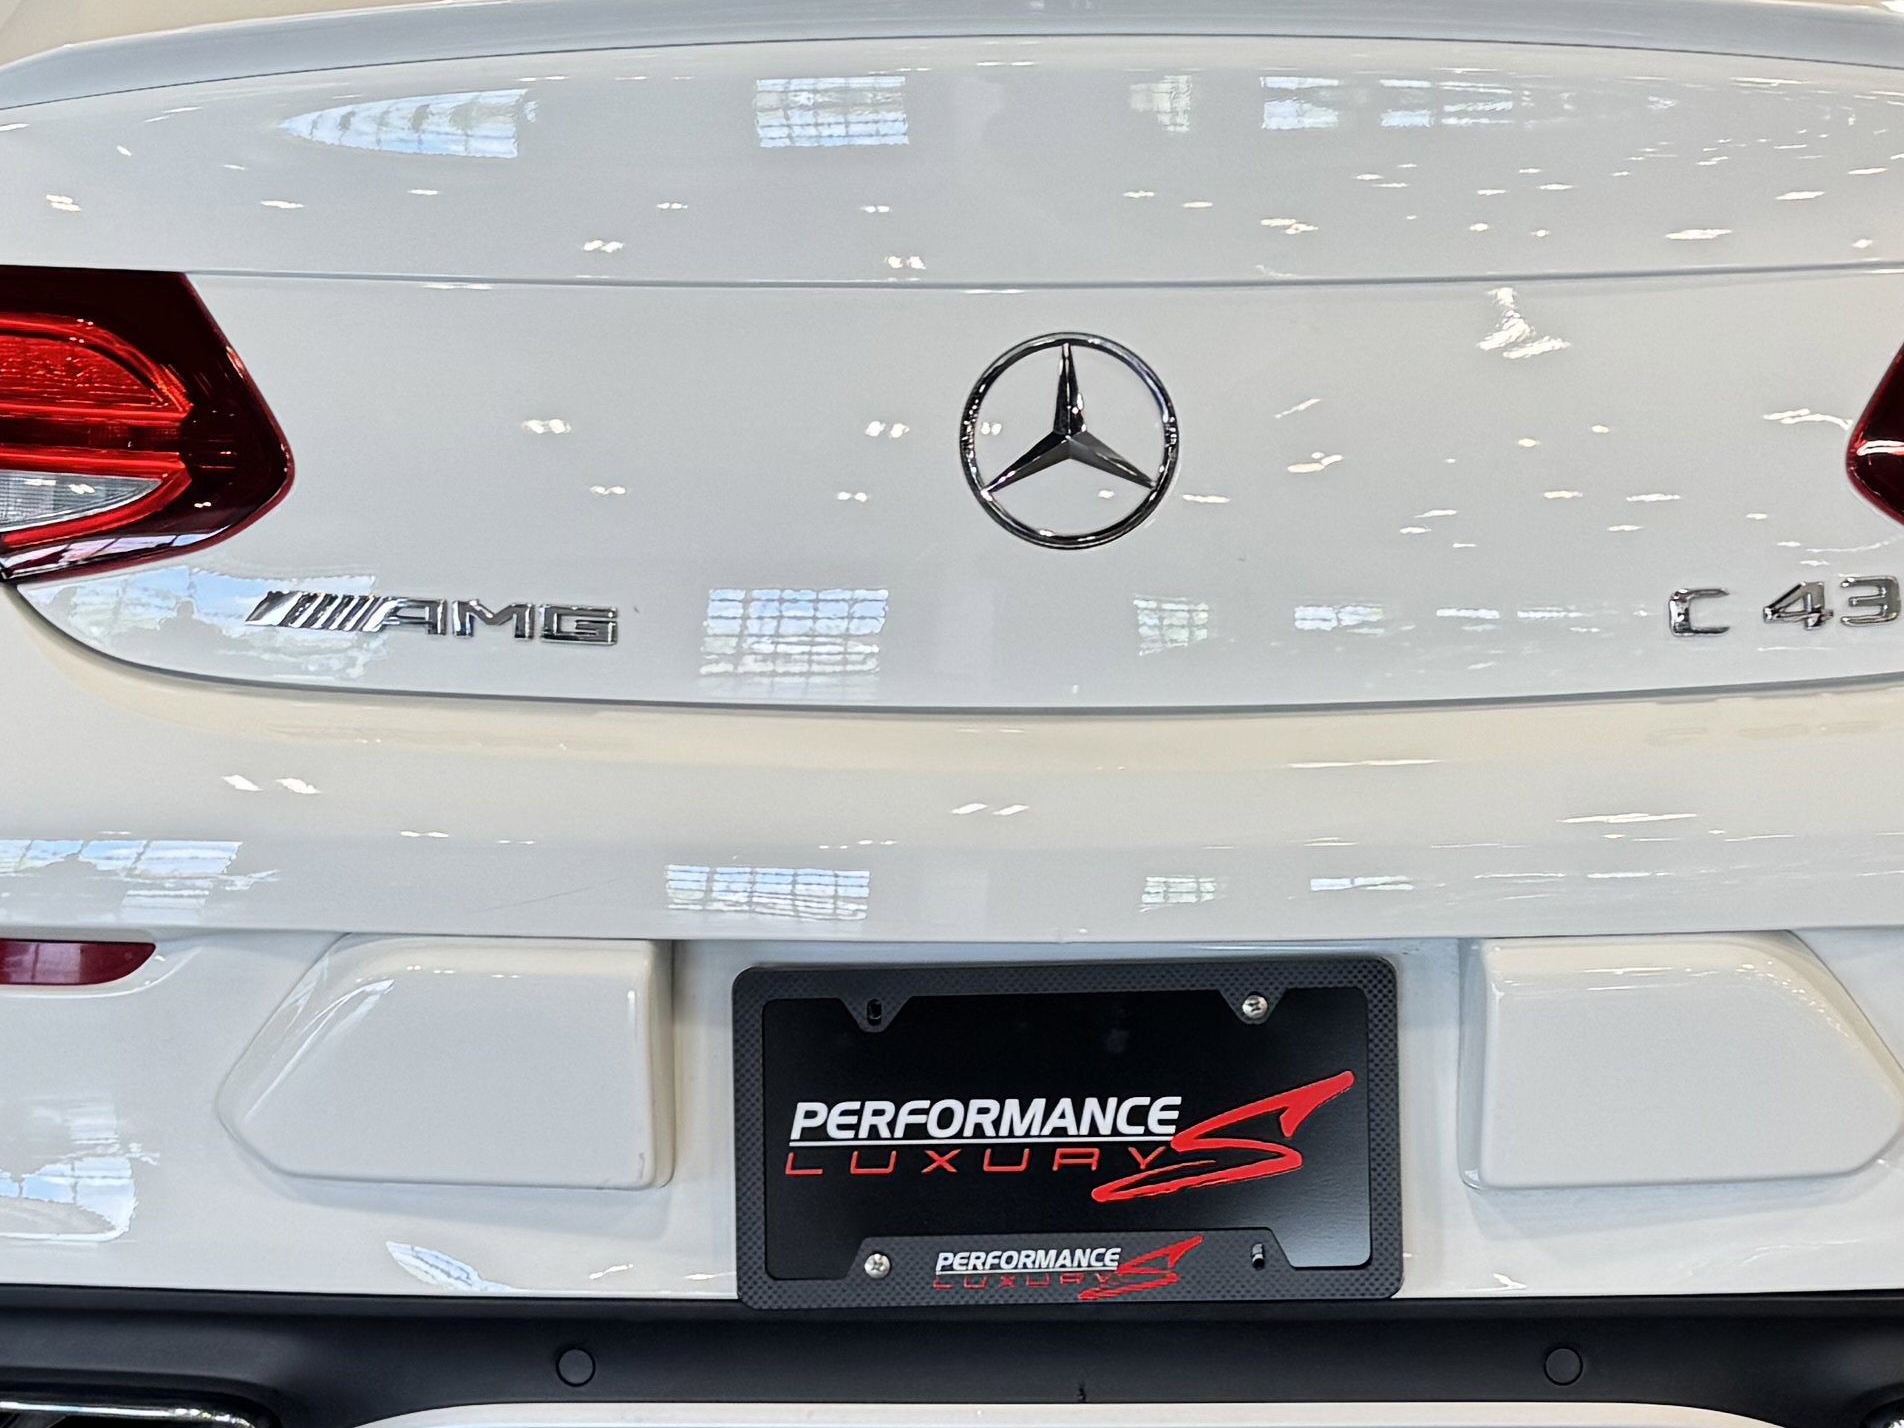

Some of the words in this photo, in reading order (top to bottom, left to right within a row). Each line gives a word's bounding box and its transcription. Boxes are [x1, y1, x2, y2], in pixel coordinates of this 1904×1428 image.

[379, 595, 619, 647] AMG
[1668, 587, 1730, 638] C
[1762, 574, 1902, 631] 43
[789, 1095, 1183, 1141] PERFORMANCE
[784, 1145, 1167, 1176] LUXURY
[935, 1247, 1122, 1272] PERFORMANCE
[932, 1272, 1112, 1291] LUXURY
